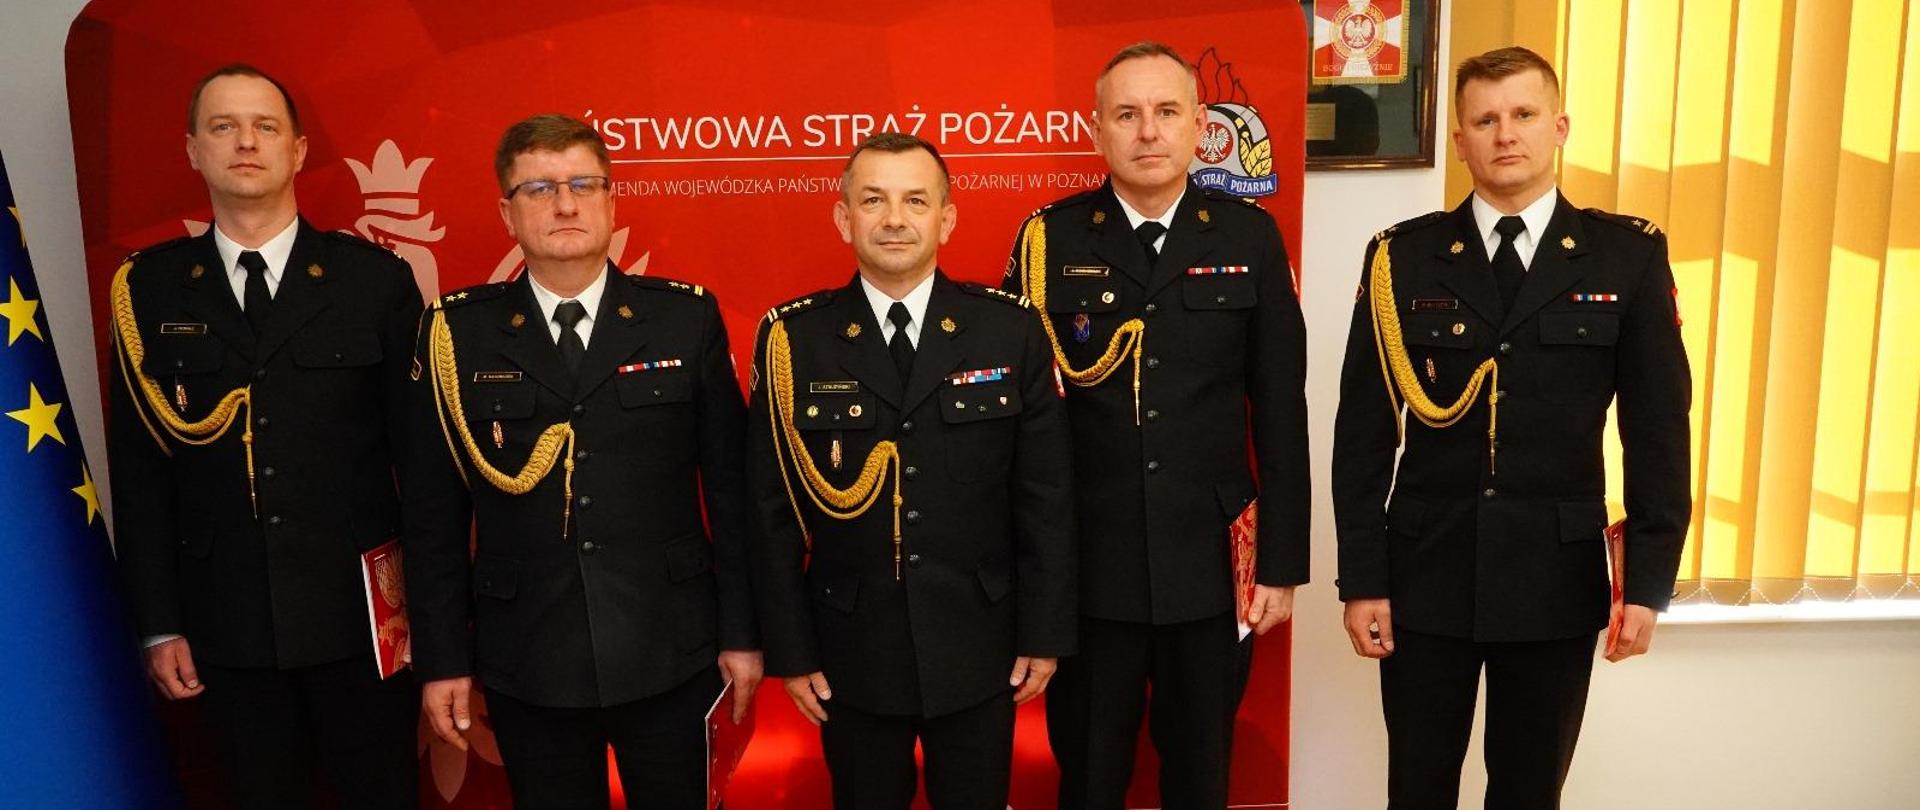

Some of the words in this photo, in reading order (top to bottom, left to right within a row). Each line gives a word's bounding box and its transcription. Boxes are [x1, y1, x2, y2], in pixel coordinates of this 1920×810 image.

[803, 104, 927, 149] STRAŻ
[940, 103, 1097, 145] POŻARN
[664, 175, 774, 199] WOJEWÓDZKA
[949, 172, 1023, 192] POŻARNEJ
[1028, 174, 1043, 188] W
